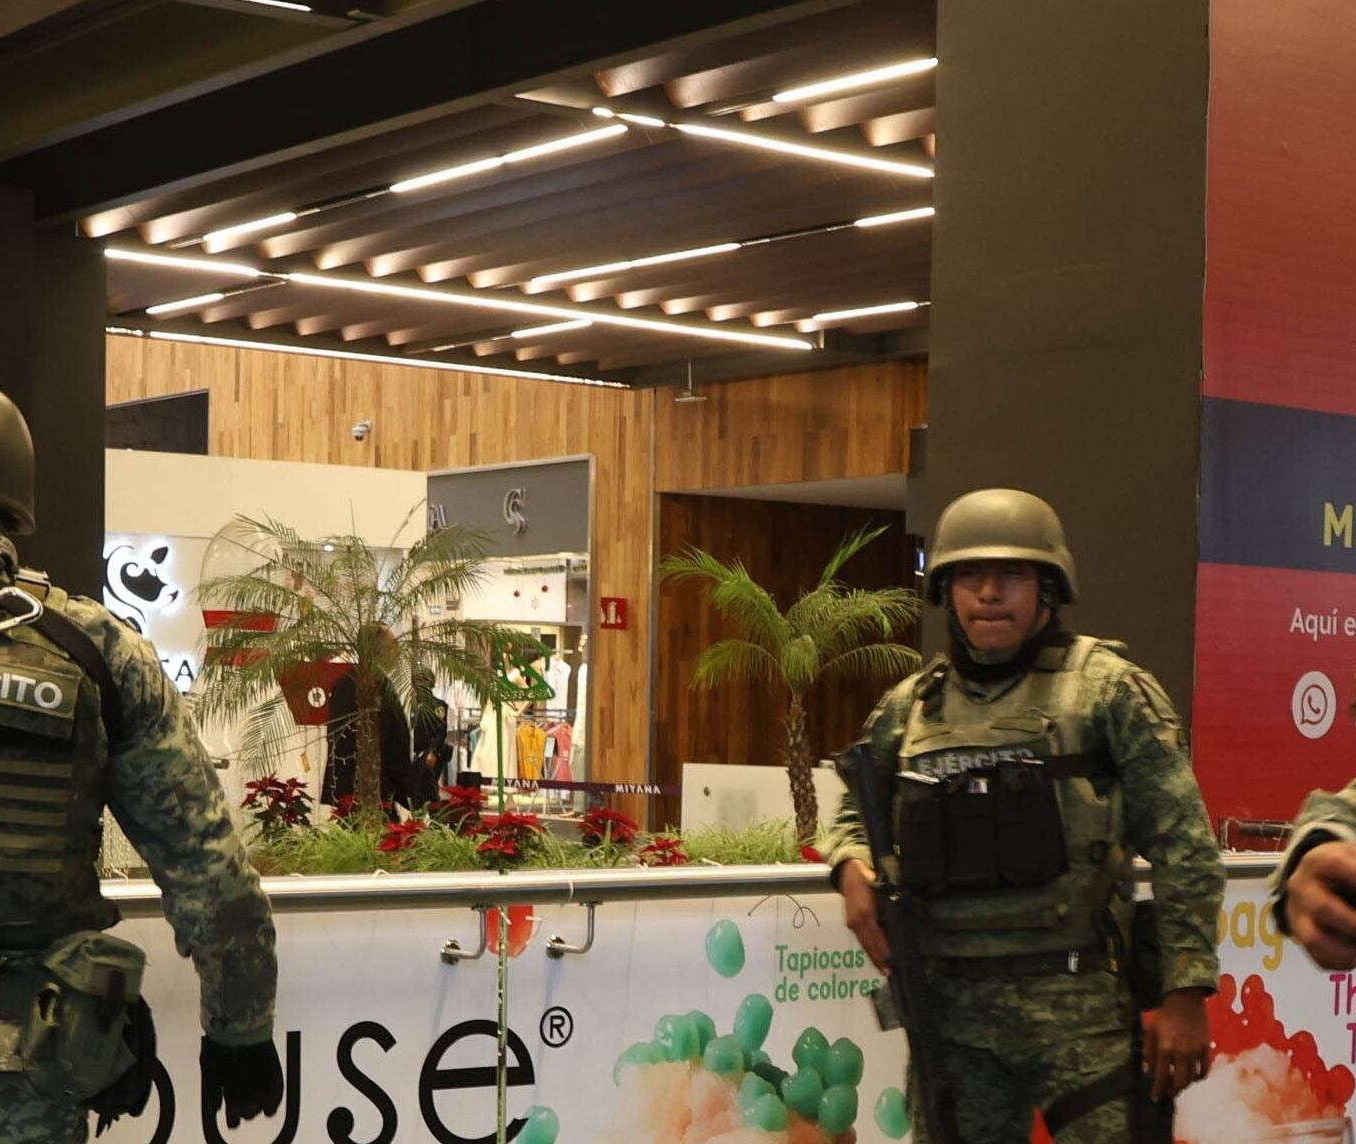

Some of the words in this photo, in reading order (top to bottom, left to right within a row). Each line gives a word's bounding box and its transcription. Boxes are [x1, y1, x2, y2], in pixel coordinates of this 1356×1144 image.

[1290, 608, 1338, 642] Aquí
[916, 748, 1036, 777] EJÉRCITO
[615, 783, 661, 796] MIYANA
[775, 944, 865, 980] Tapiocas
[775, 975, 799, 1003] de
[808, 972, 881, 1001] colores
